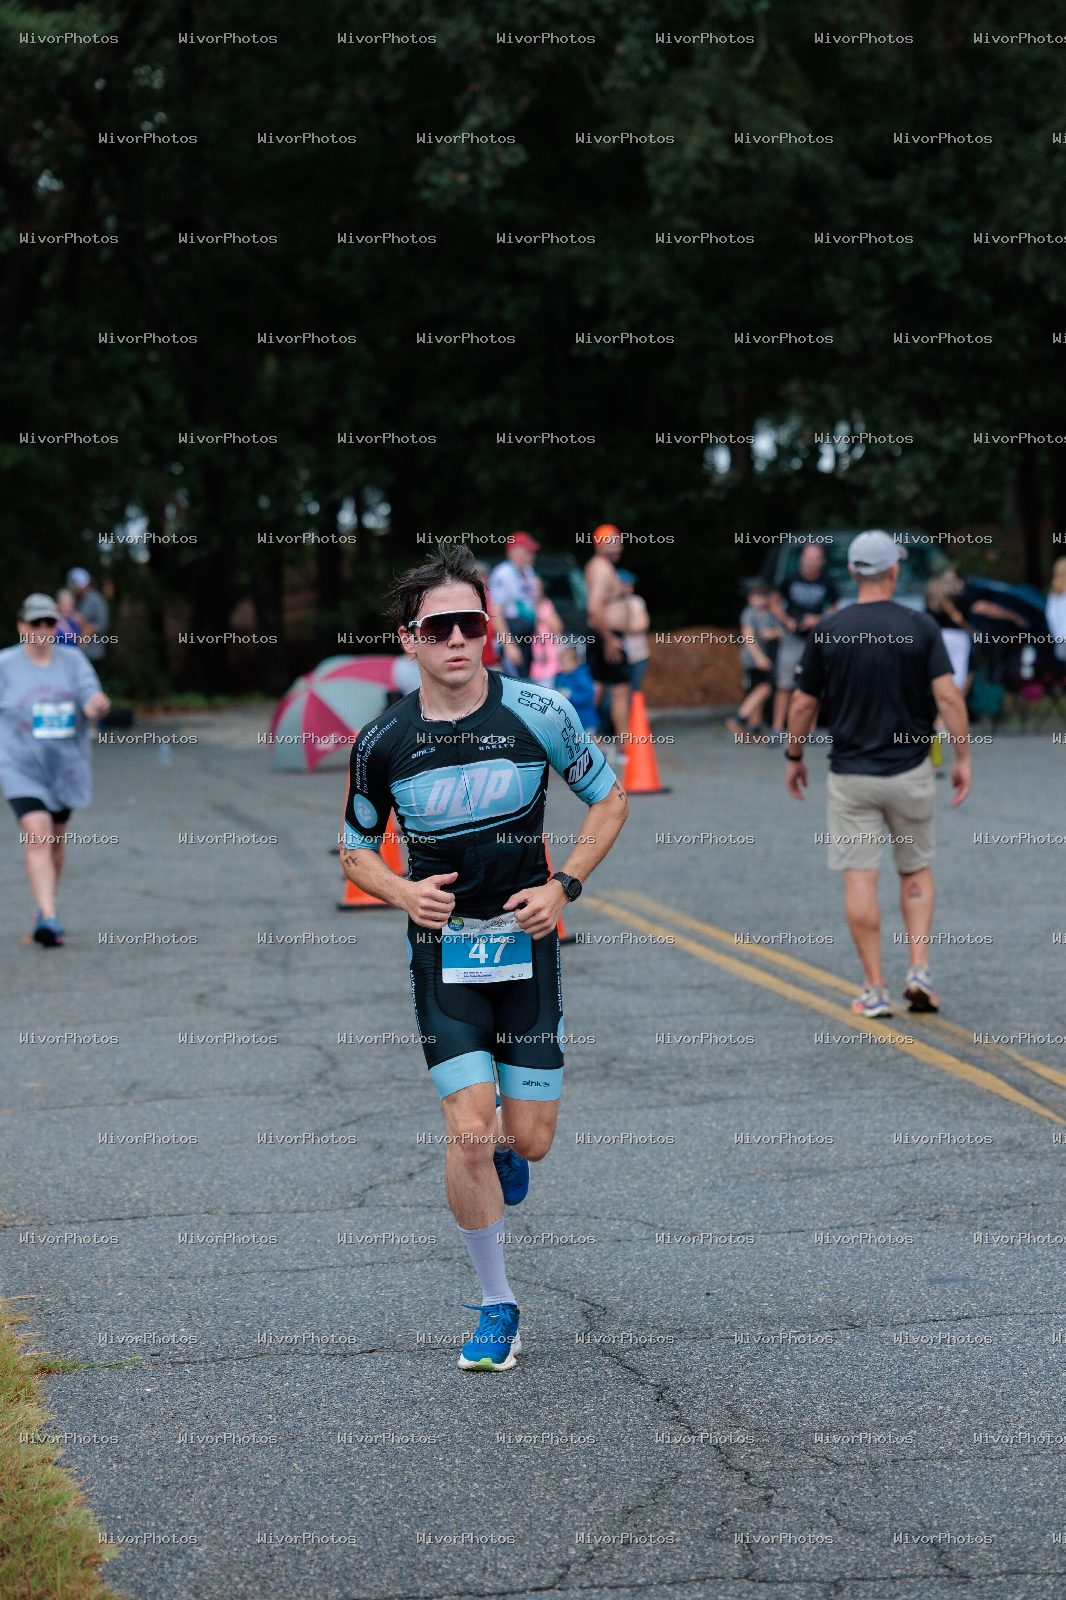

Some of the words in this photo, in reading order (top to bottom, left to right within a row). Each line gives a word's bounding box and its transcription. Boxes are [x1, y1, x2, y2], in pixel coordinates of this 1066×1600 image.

[358, 724, 379, 752] Center
[362, 717, 398, 765] Replacement
[468, 937, 509, 964] 47
